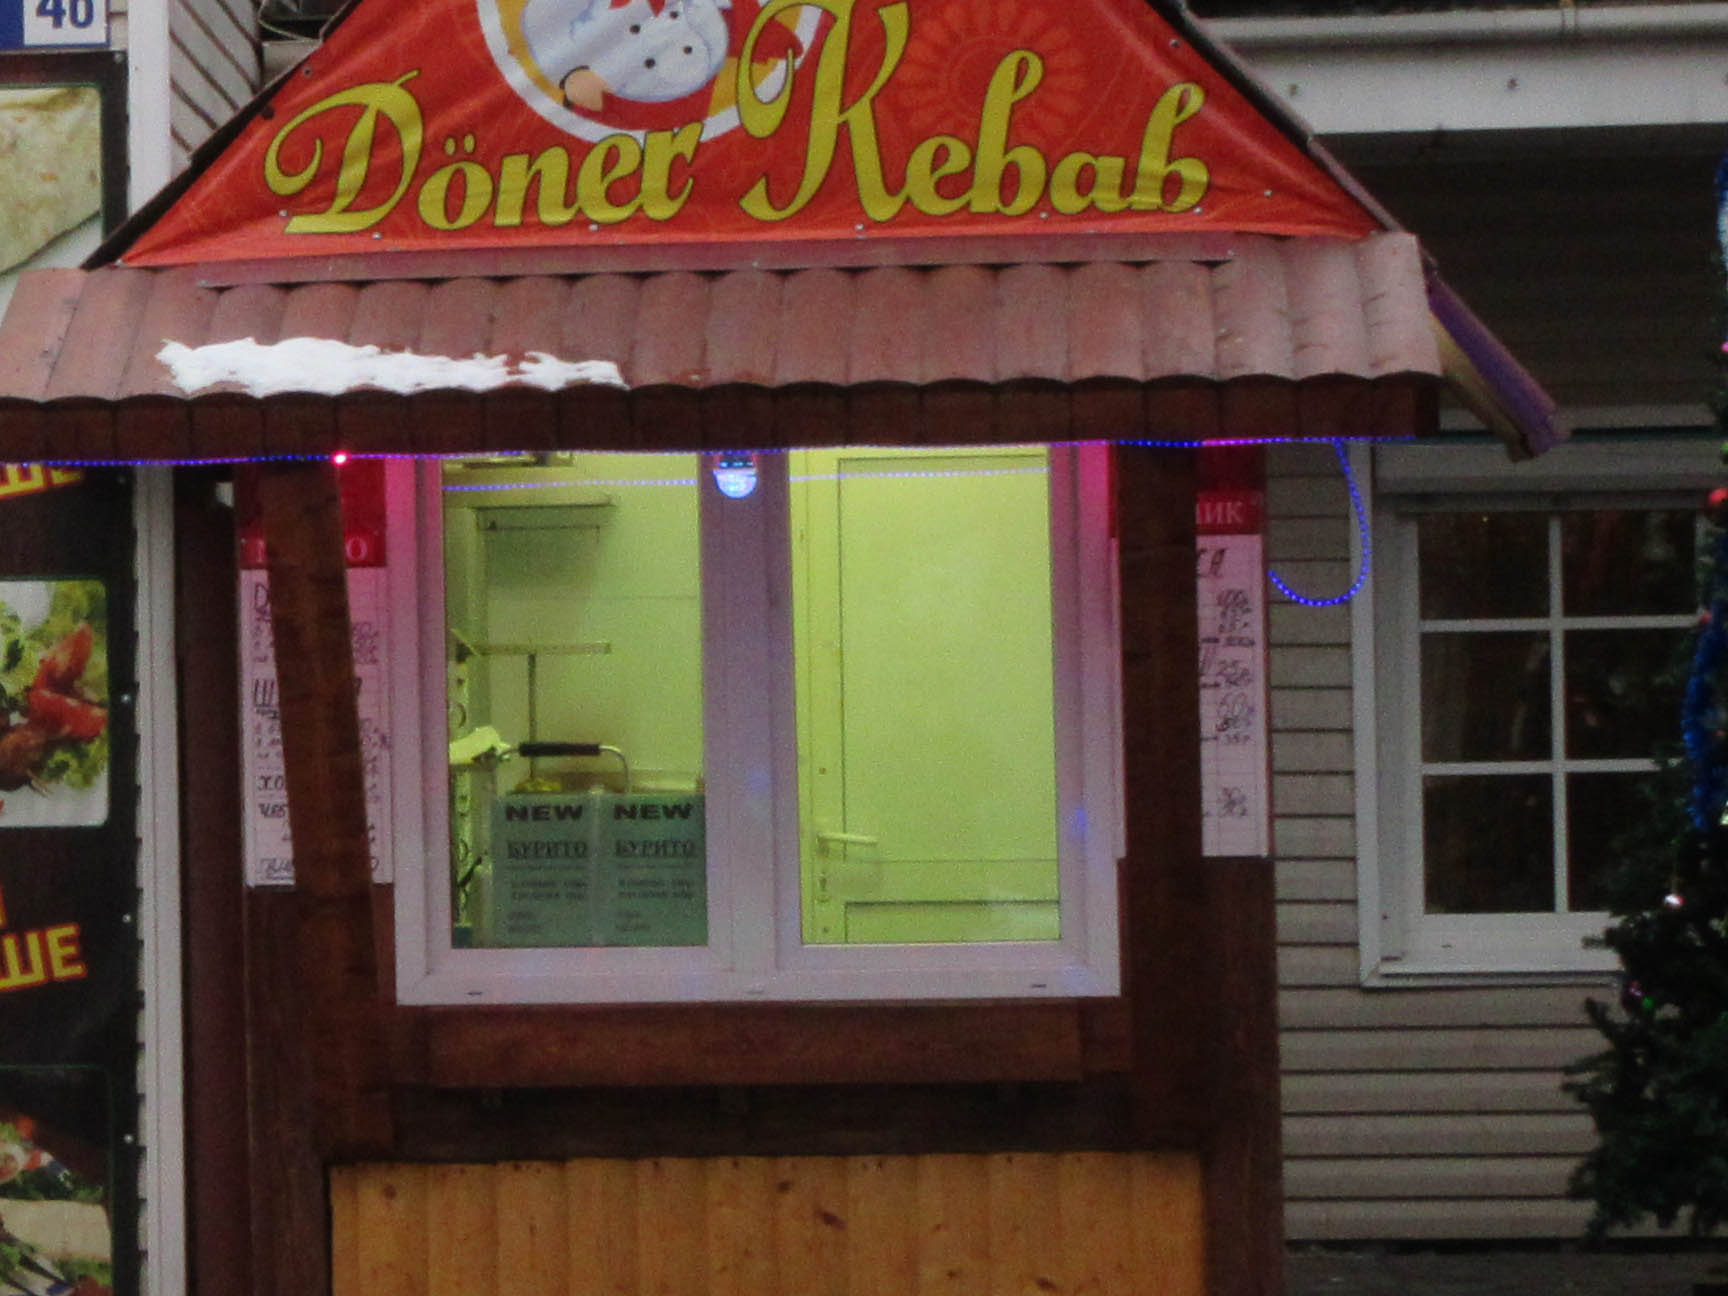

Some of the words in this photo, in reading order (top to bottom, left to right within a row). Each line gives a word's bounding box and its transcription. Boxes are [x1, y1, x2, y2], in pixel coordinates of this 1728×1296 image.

[264, 68, 704, 235] Döner
[505, 804, 584, 821] NEW
[613, 803, 693, 820] NEW
